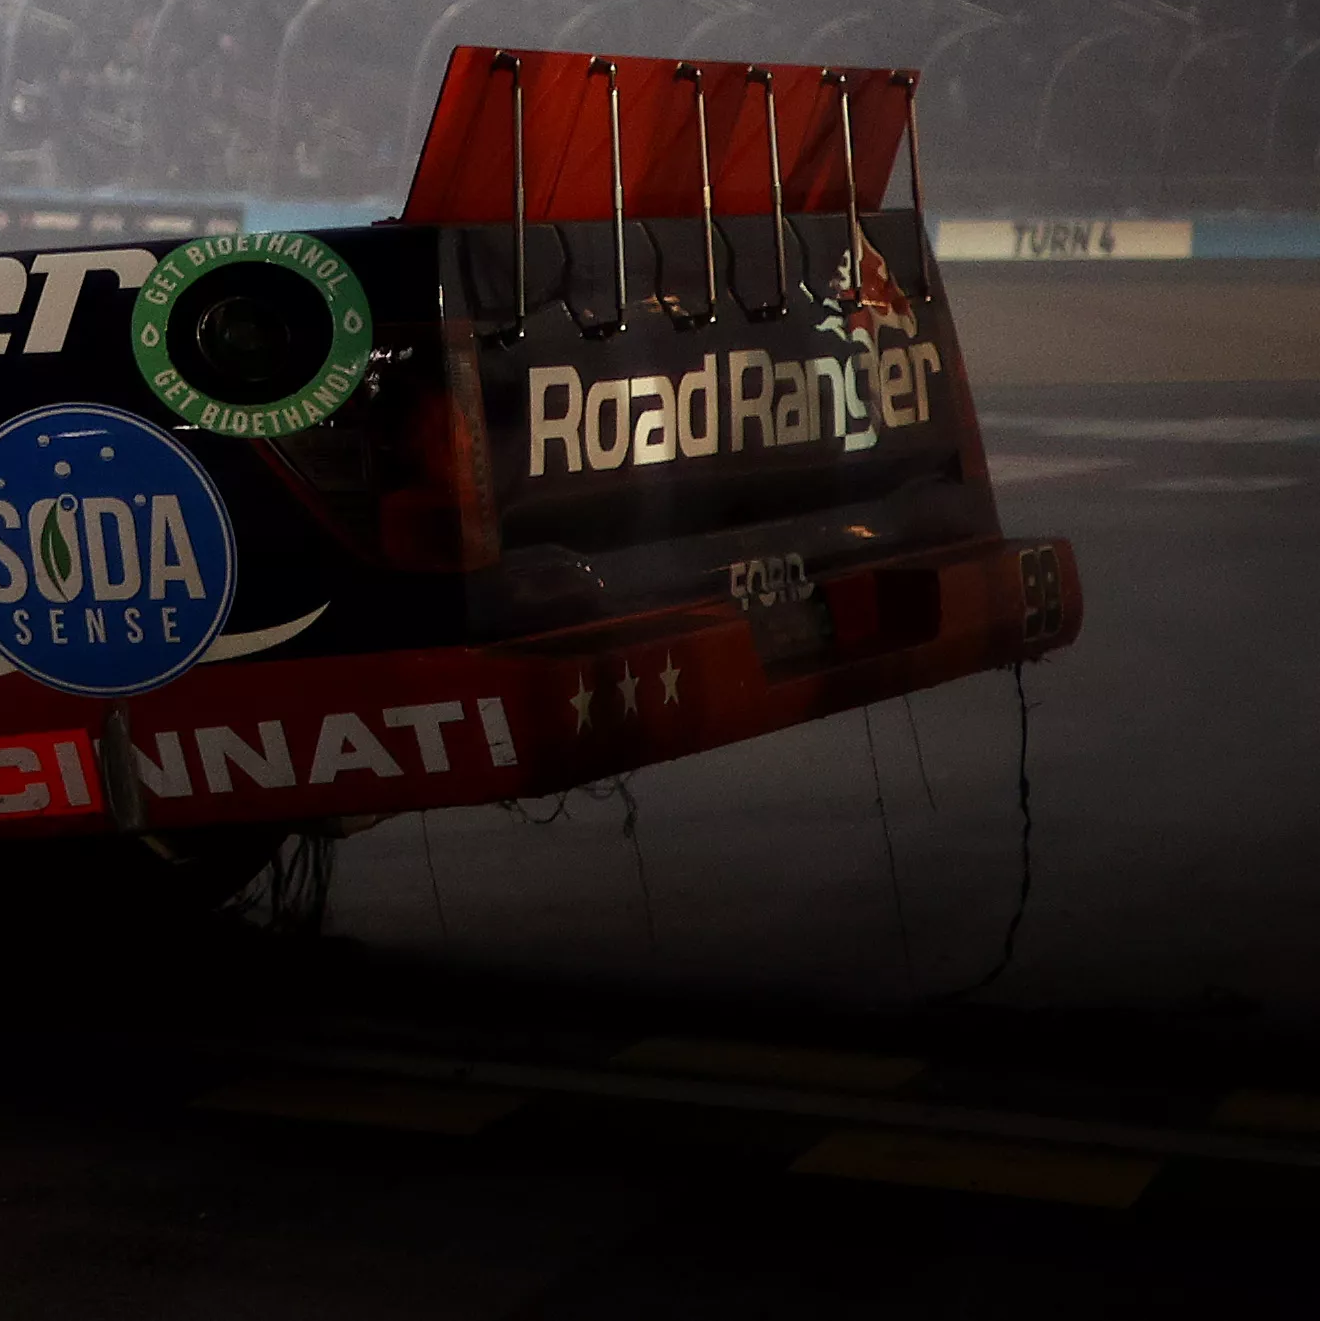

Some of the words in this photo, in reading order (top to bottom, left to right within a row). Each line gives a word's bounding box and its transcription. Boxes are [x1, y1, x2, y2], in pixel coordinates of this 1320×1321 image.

[144, 260, 187, 308] GET
[186, 231, 352, 301] BIOETHANOL
[1014, 221, 1091, 256] TURN
[1097, 221, 1117, 255] 4
[153, 368, 199, 412] GET
[198, 355, 365, 437] BIOETHANOL
[528, 353, 719, 478] Road
[729, 340, 941, 453] Ranger
[12, 606, 182, 646] SENSE
